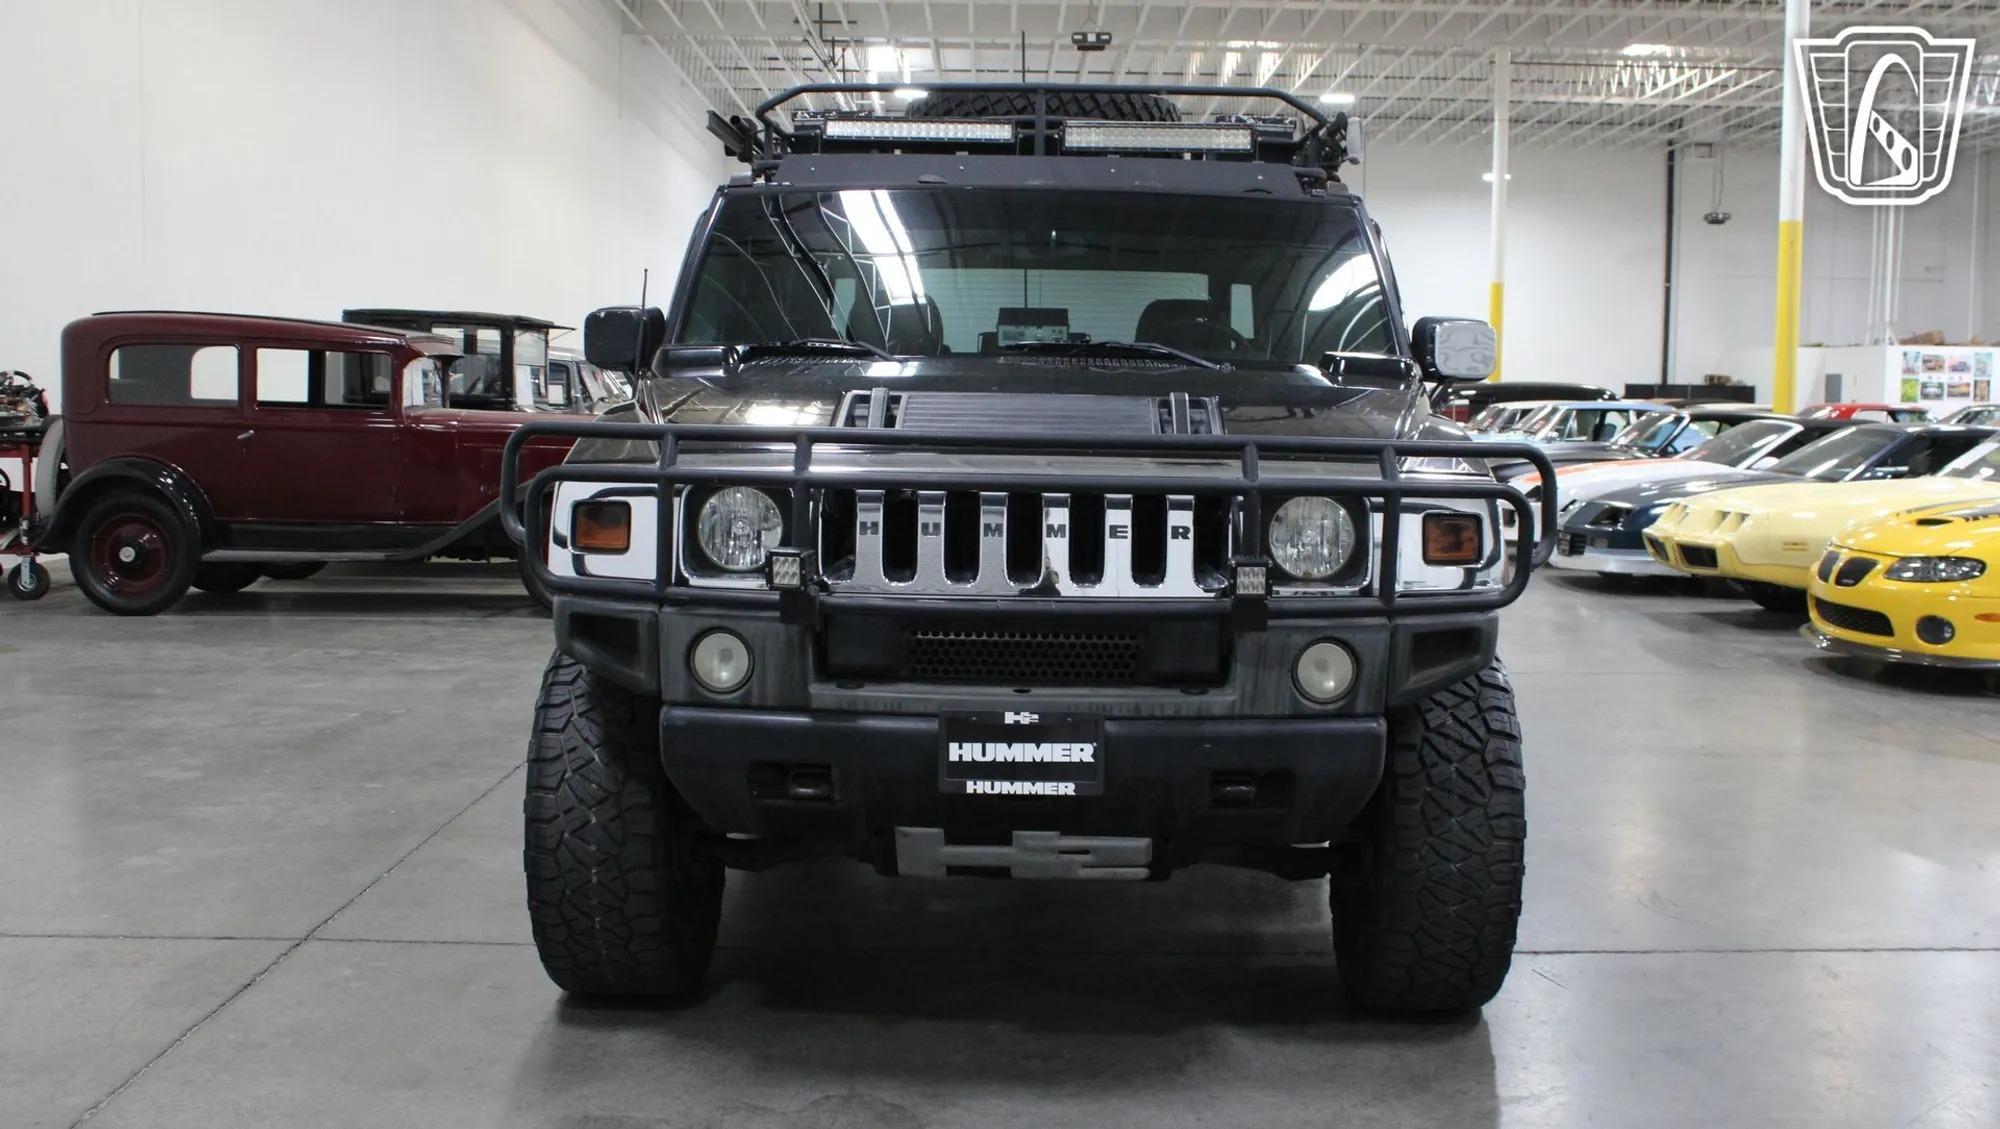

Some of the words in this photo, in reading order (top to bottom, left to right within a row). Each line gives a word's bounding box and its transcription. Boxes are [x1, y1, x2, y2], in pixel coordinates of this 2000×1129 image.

[858, 521, 1191, 540] HUMMER
[949, 742, 1096, 763] HUMMER
[966, 780, 1076, 796] HUMMER
